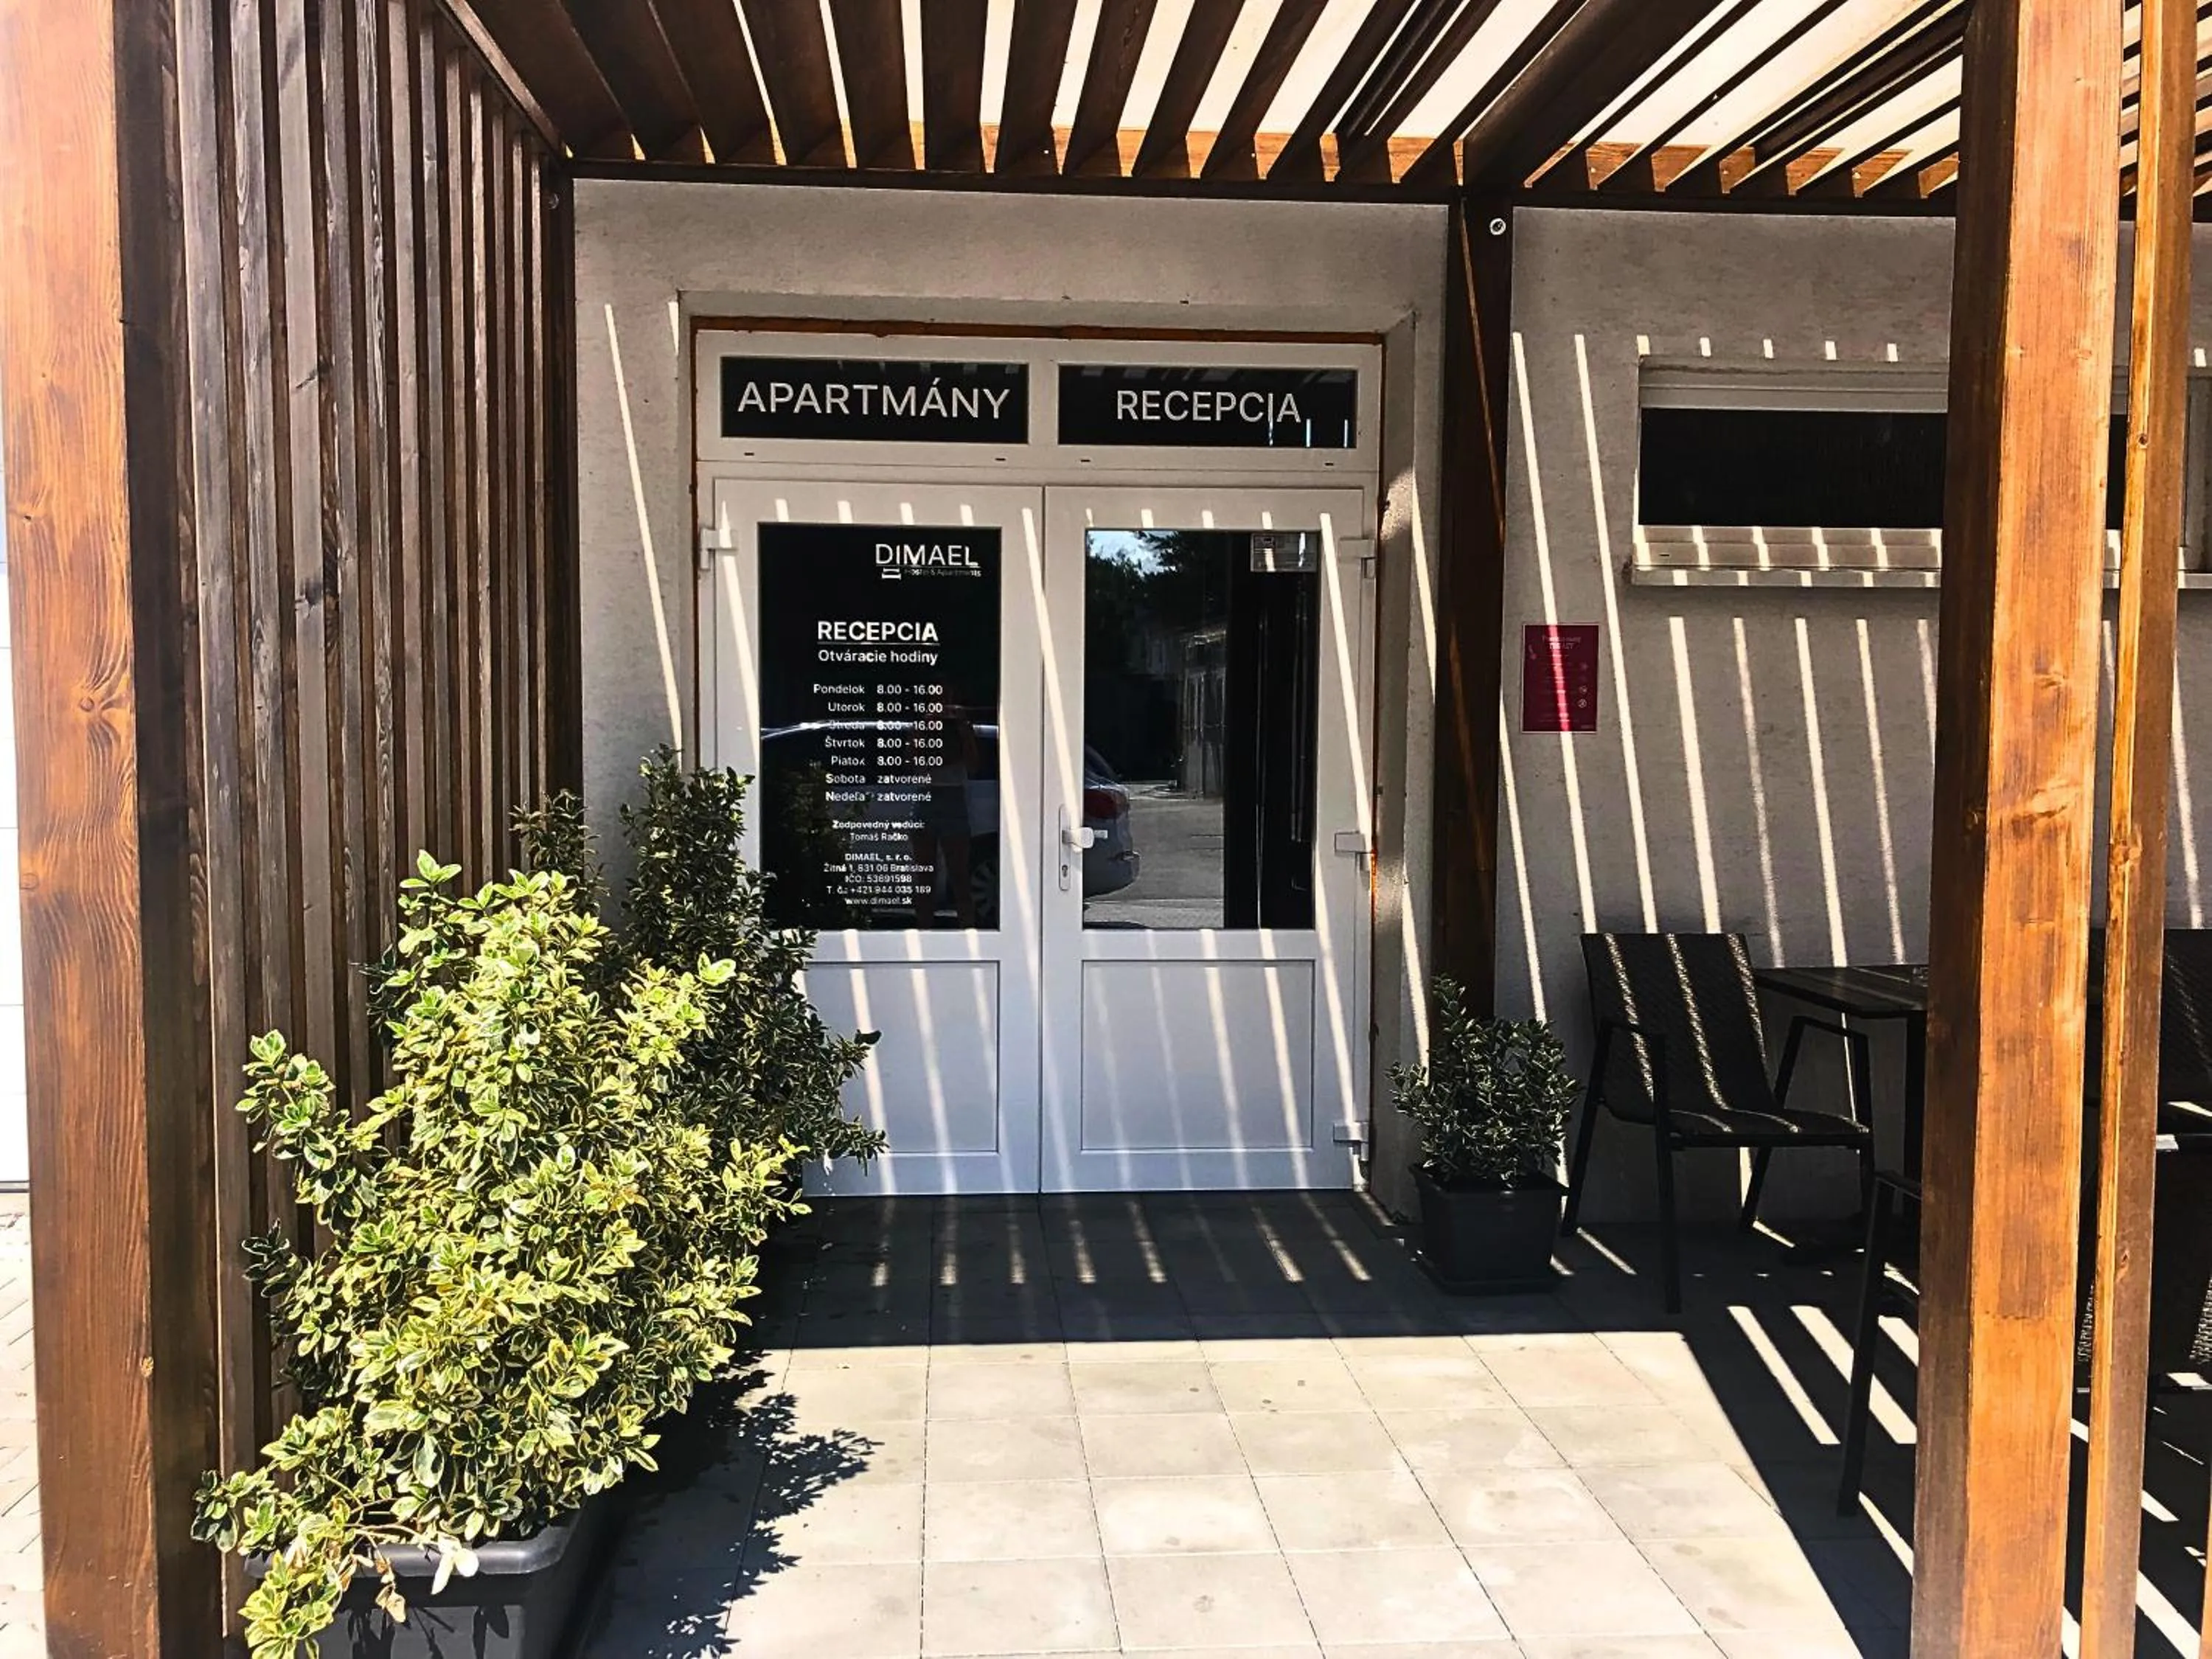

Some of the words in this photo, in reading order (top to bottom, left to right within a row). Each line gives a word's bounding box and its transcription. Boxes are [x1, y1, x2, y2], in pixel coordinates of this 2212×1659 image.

[737, 378, 1010, 419] APARTMÁNY
[1117, 390, 1301, 423] RECEPCIA
[875, 544, 979, 566] DIMAEL
[818, 622, 939, 641] RECEPCIA
[818, 650, 886, 662] Otváracie
[891, 651, 938, 665] hodiny
[813, 684, 865, 694] Pondelok
[877, 685, 901, 695] 8.00
[914, 685, 943, 695] 16.00
[828, 703, 865, 712] Utorok
[877, 703, 901, 712] 8.00
[914, 703, 943, 712] 16.00
[914, 720, 943, 730] 16.00
[825, 736, 865, 748] Štvrtok
[877, 739, 901, 748] 8.00
[914, 739, 943, 748] 16.00
[831, 756, 866, 765] Piatok
[877, 757, 901, 765] 8.00
[914, 757, 943, 765] 16.00
[826, 774, 866, 784] Sobota
[877, 774, 932, 784] zatvorené
[826, 791, 865, 801] Nedeľa
[877, 791, 932, 801] zatvorené
[832, 820, 888, 830] Zodpovedný
[891, 820, 925, 828] vedúci:
[849, 832, 879, 841] Tomáš
[881, 832, 908, 841] Račko
[824, 863, 846, 872] Žitná
